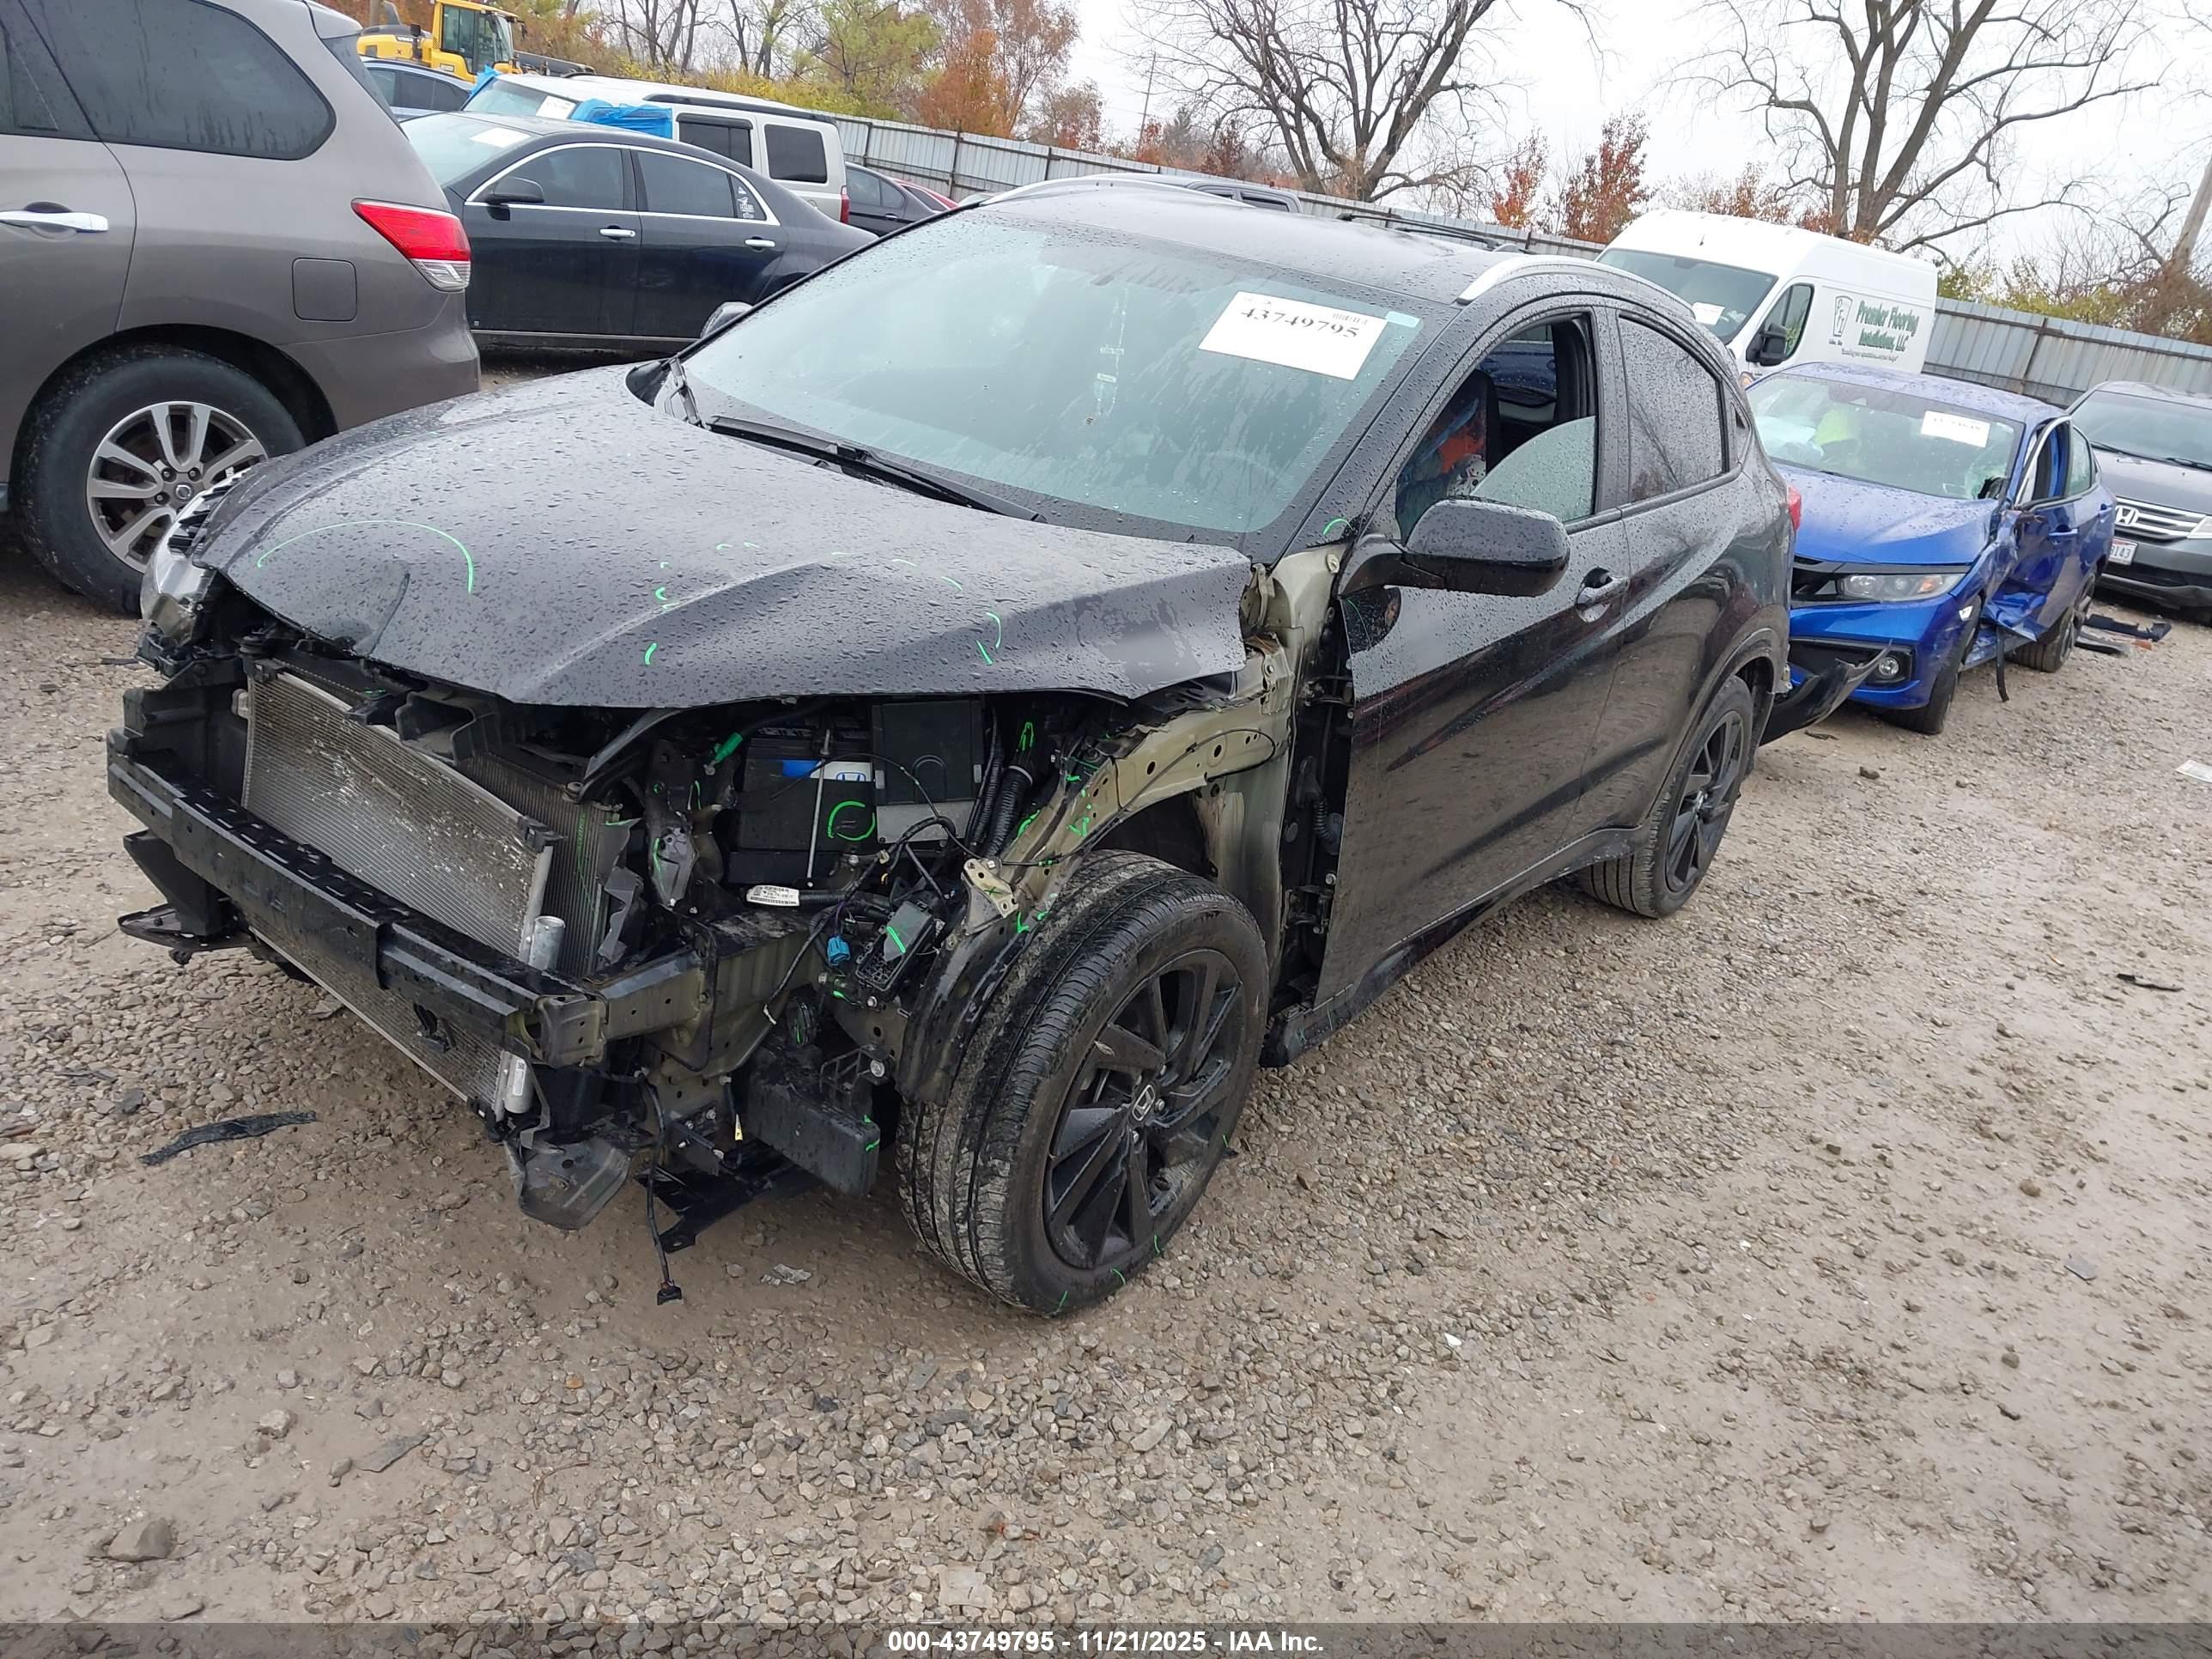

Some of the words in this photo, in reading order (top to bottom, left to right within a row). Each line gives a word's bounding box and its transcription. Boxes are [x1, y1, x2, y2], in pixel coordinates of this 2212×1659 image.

[1240, 307, 1360, 337] 43749795
[1856, 301, 1889, 327] Premier
[1888, 307, 1919, 337] Flooring
[1895, 334, 1909, 352] LLC
